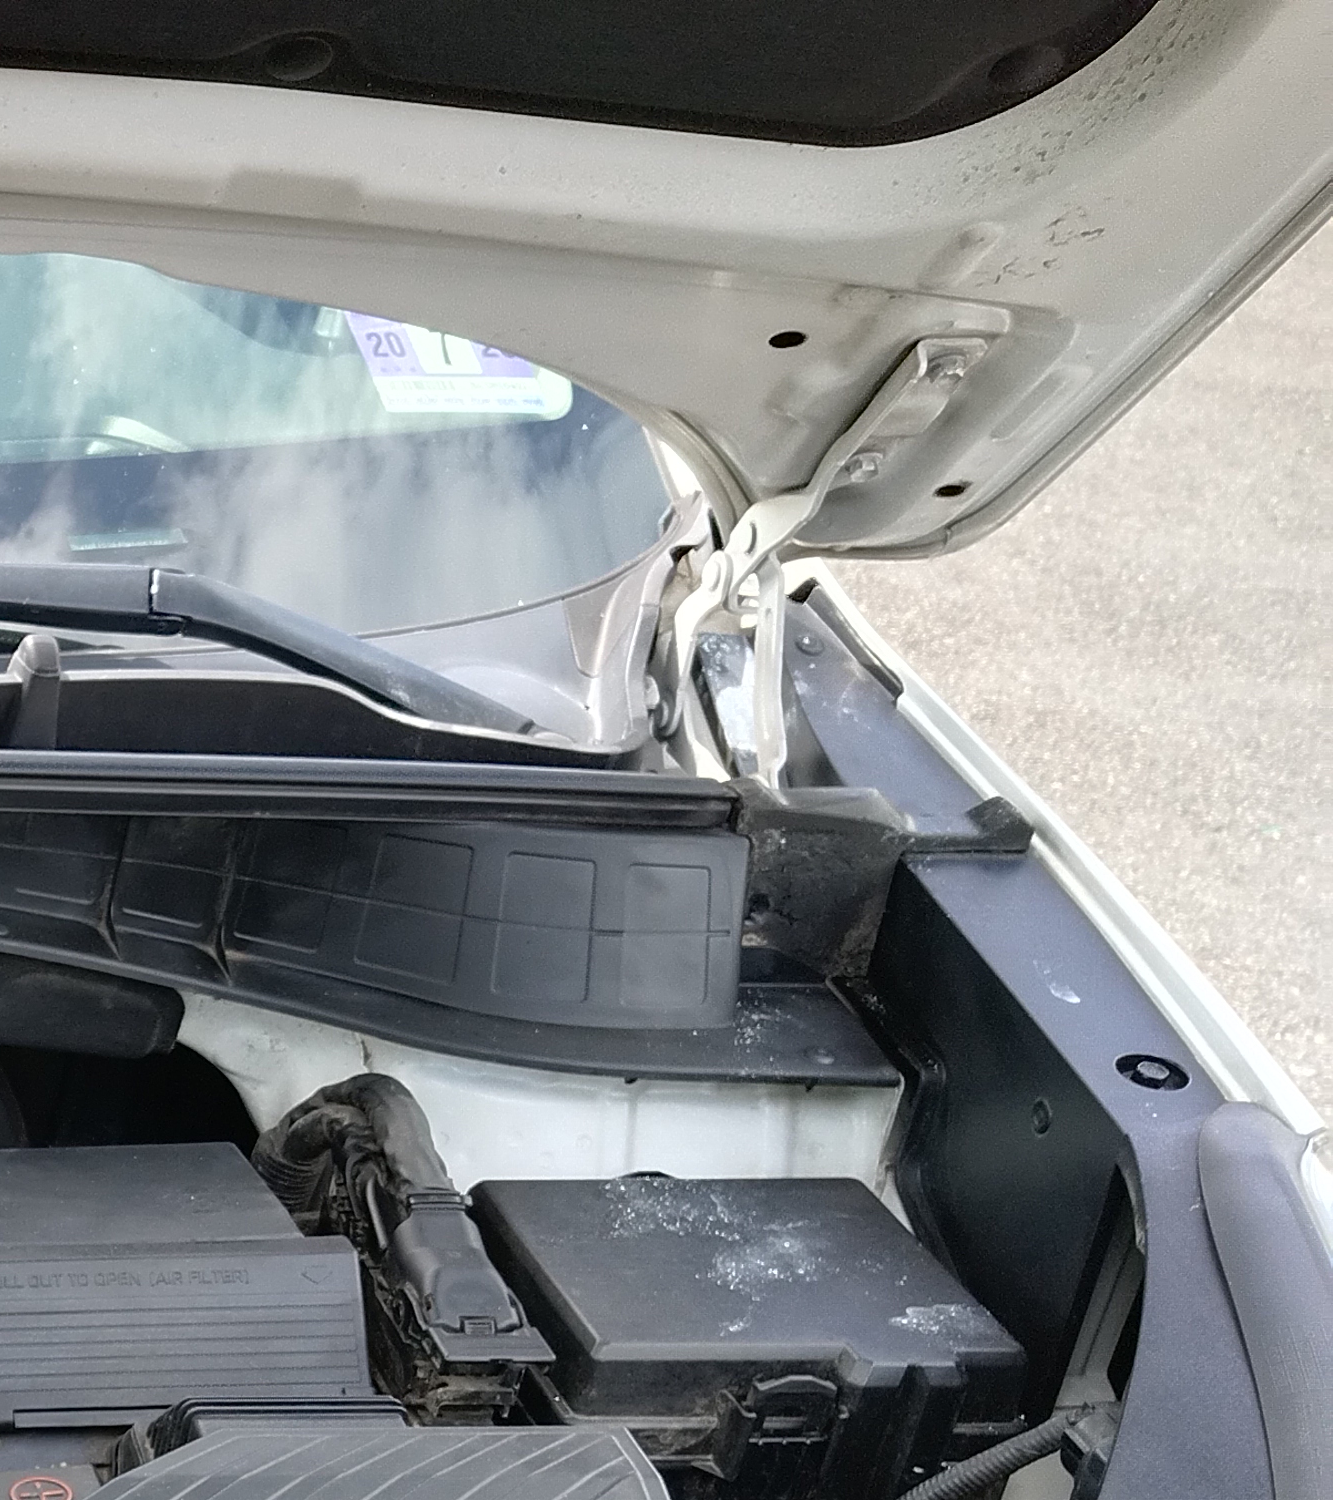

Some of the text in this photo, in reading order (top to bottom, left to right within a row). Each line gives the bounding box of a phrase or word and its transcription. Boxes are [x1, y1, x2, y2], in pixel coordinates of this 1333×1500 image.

[365, 331, 407, 359] 20
[28, 1273, 63, 1289] OUT
[68, 1272, 89, 1287] TO
[94, 1271, 141, 1287] OPEN
